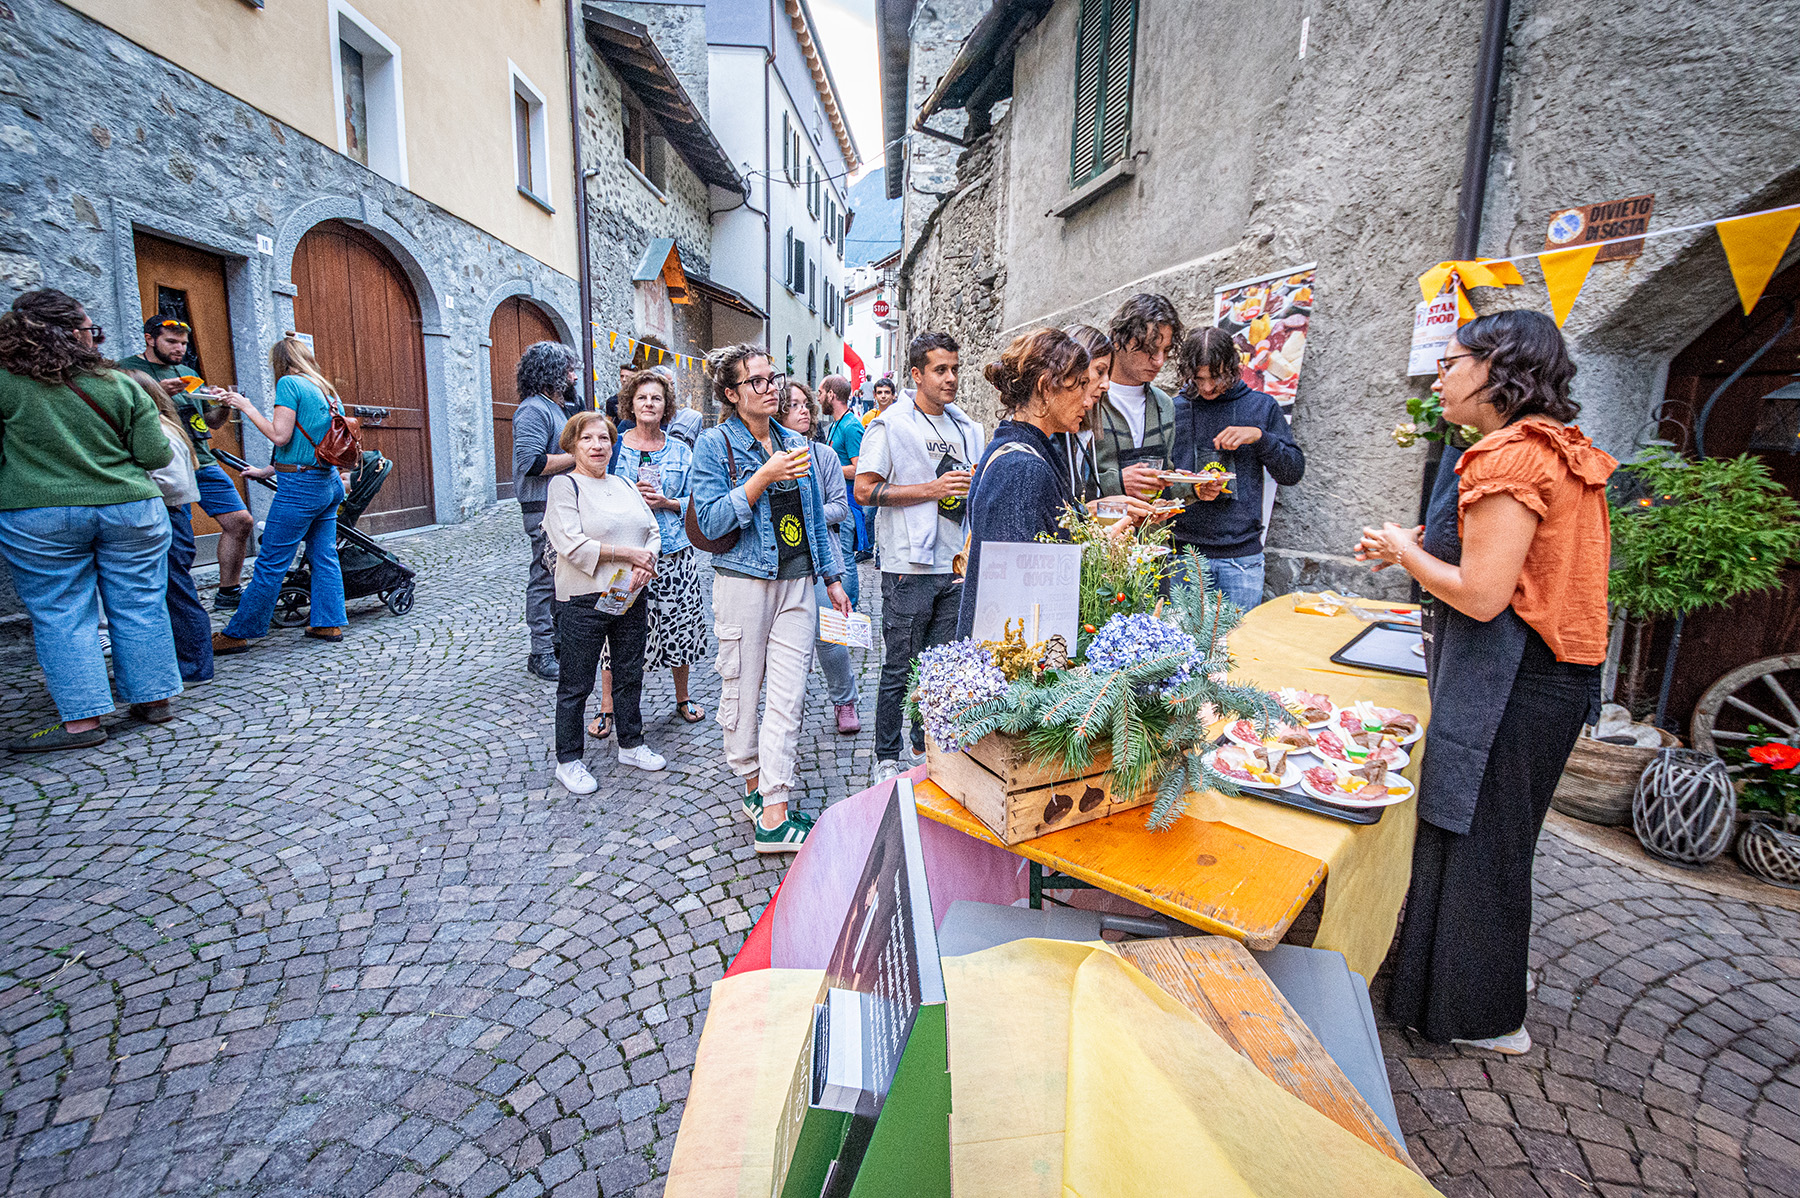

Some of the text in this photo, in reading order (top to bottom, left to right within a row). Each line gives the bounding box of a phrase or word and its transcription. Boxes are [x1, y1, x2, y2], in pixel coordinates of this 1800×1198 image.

[1589, 197, 1651, 222] DIVIETO
[1585, 218, 1645, 241] DI SOSTA
[1428, 302, 1456, 315] STAN
[1426, 313, 1455, 326] FOOD
